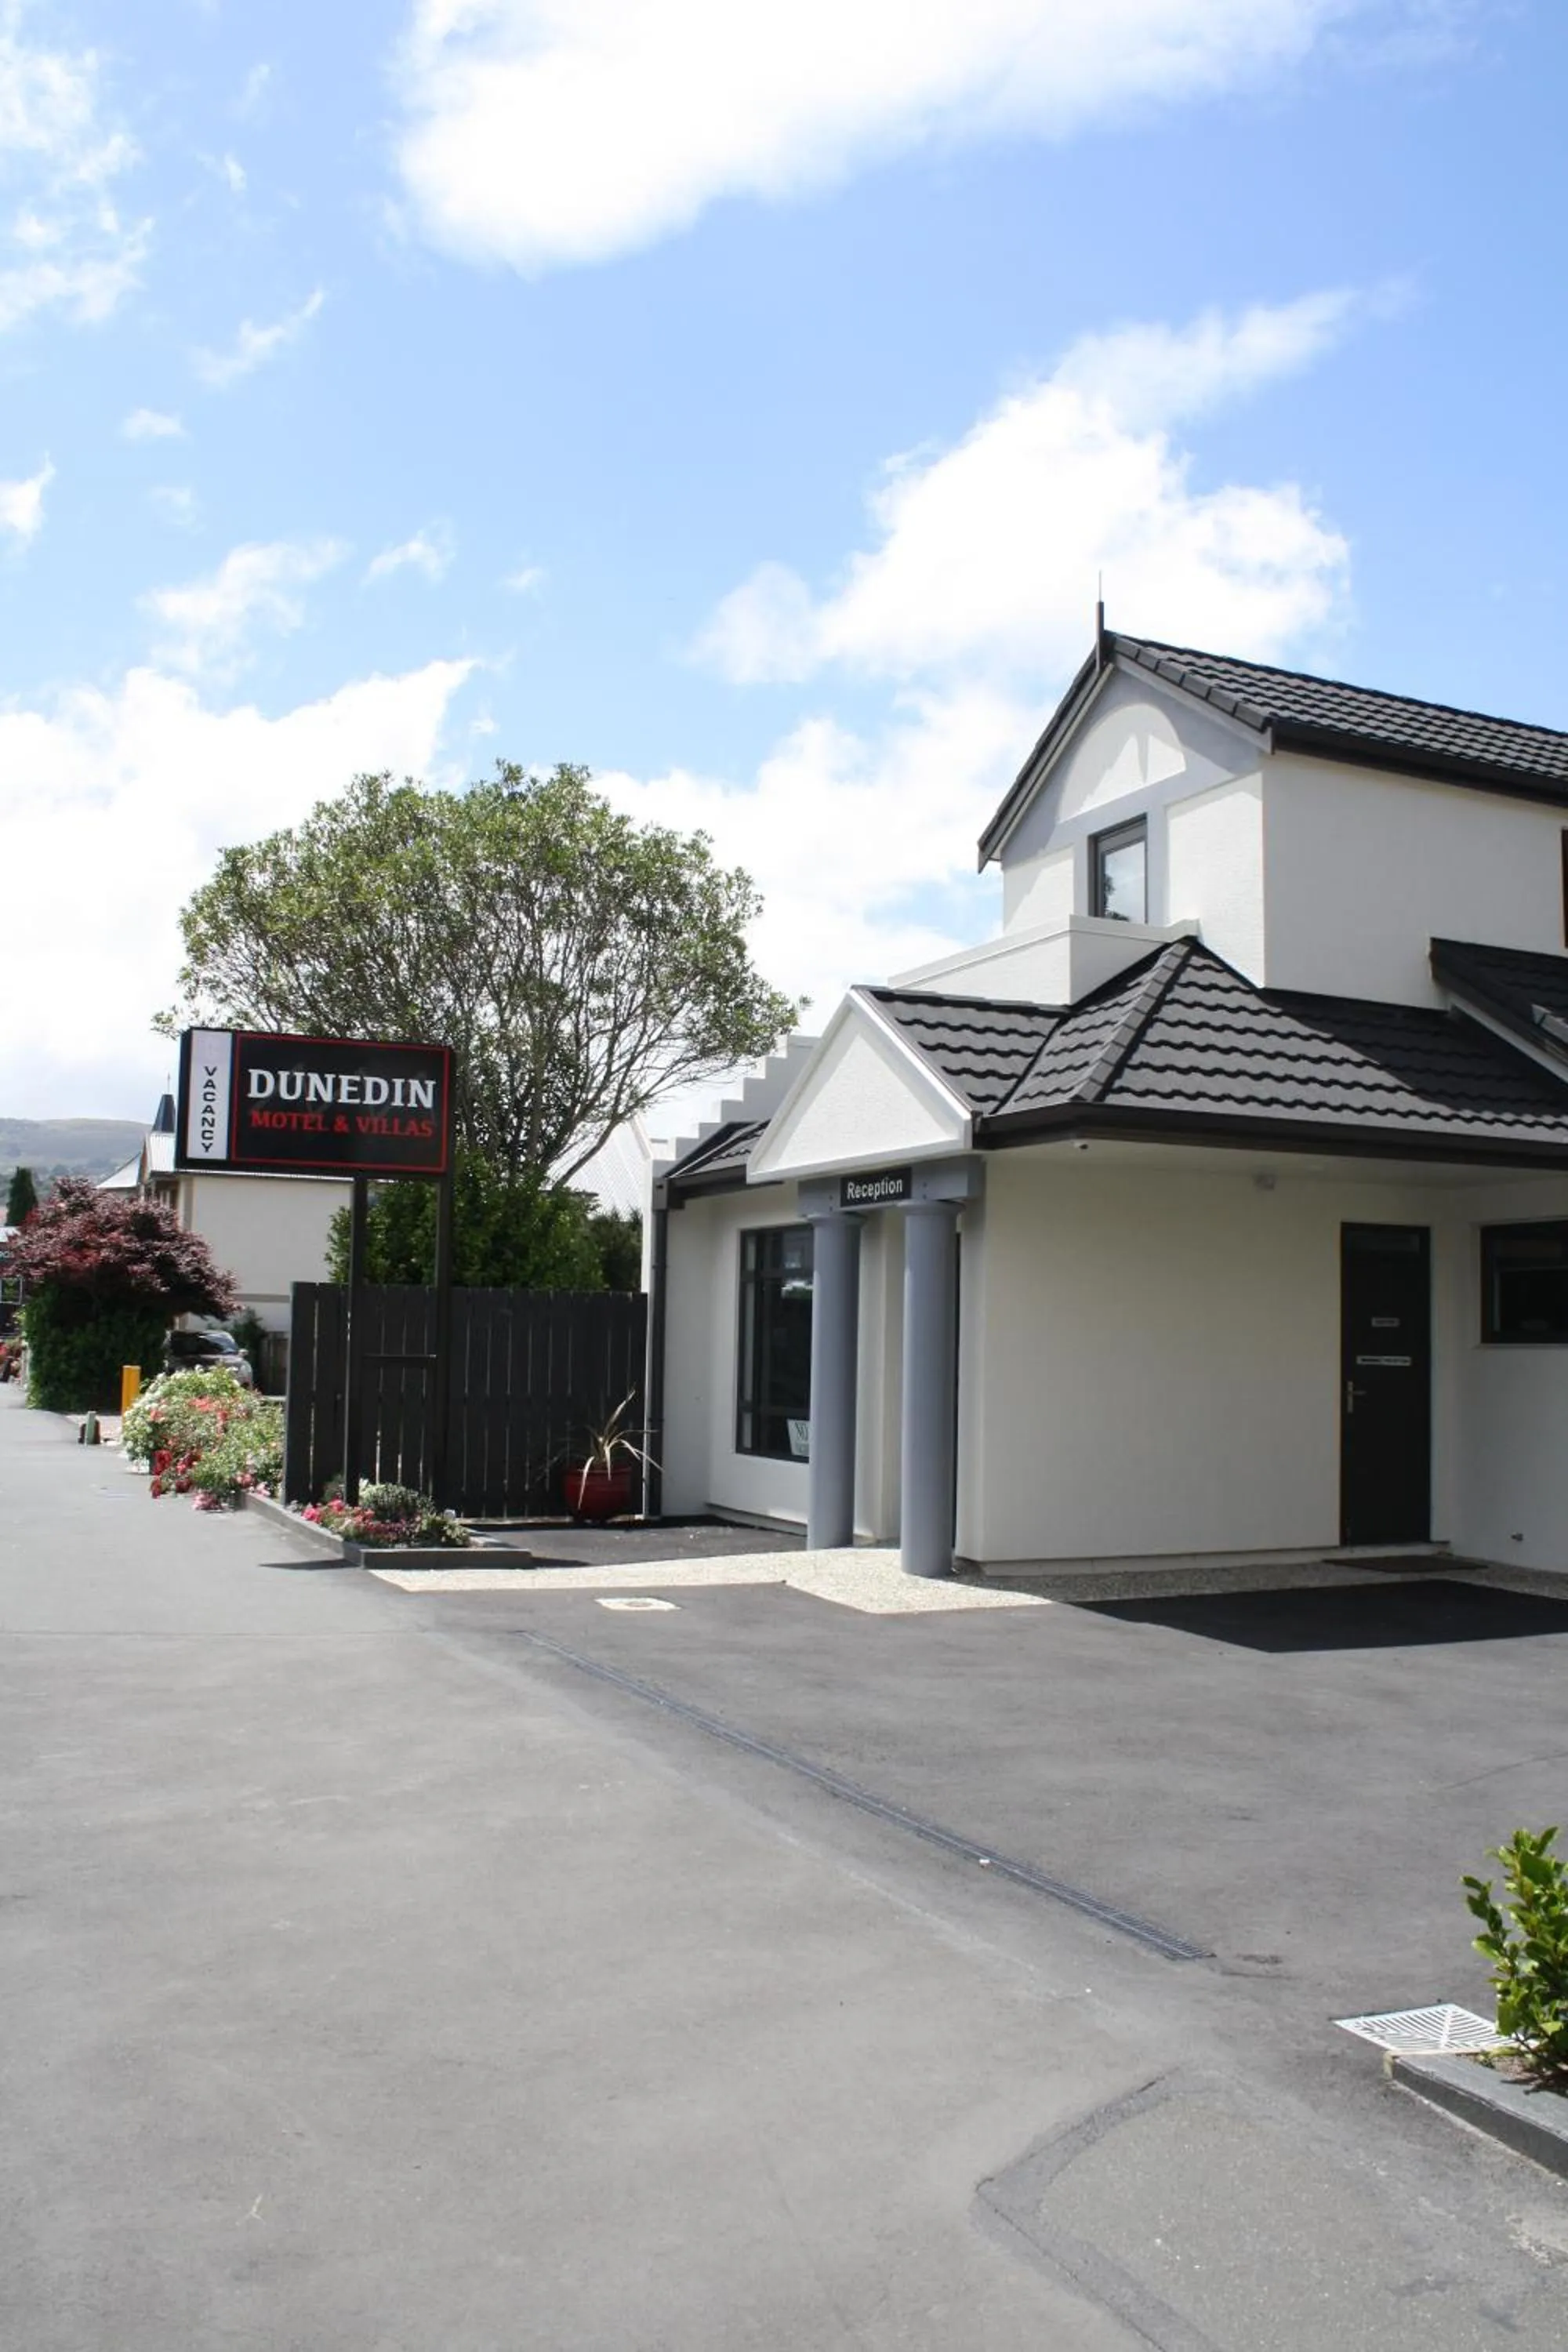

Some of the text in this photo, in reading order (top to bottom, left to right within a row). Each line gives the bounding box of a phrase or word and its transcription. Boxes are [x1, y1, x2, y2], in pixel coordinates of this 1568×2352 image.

[247, 1068, 437, 1109] DUNEDIN
[201, 1065, 217, 1153] VACANCY
[251, 1109, 435, 1138] MOTEL & VILLAS
[847, 1176, 903, 1200] Reception
